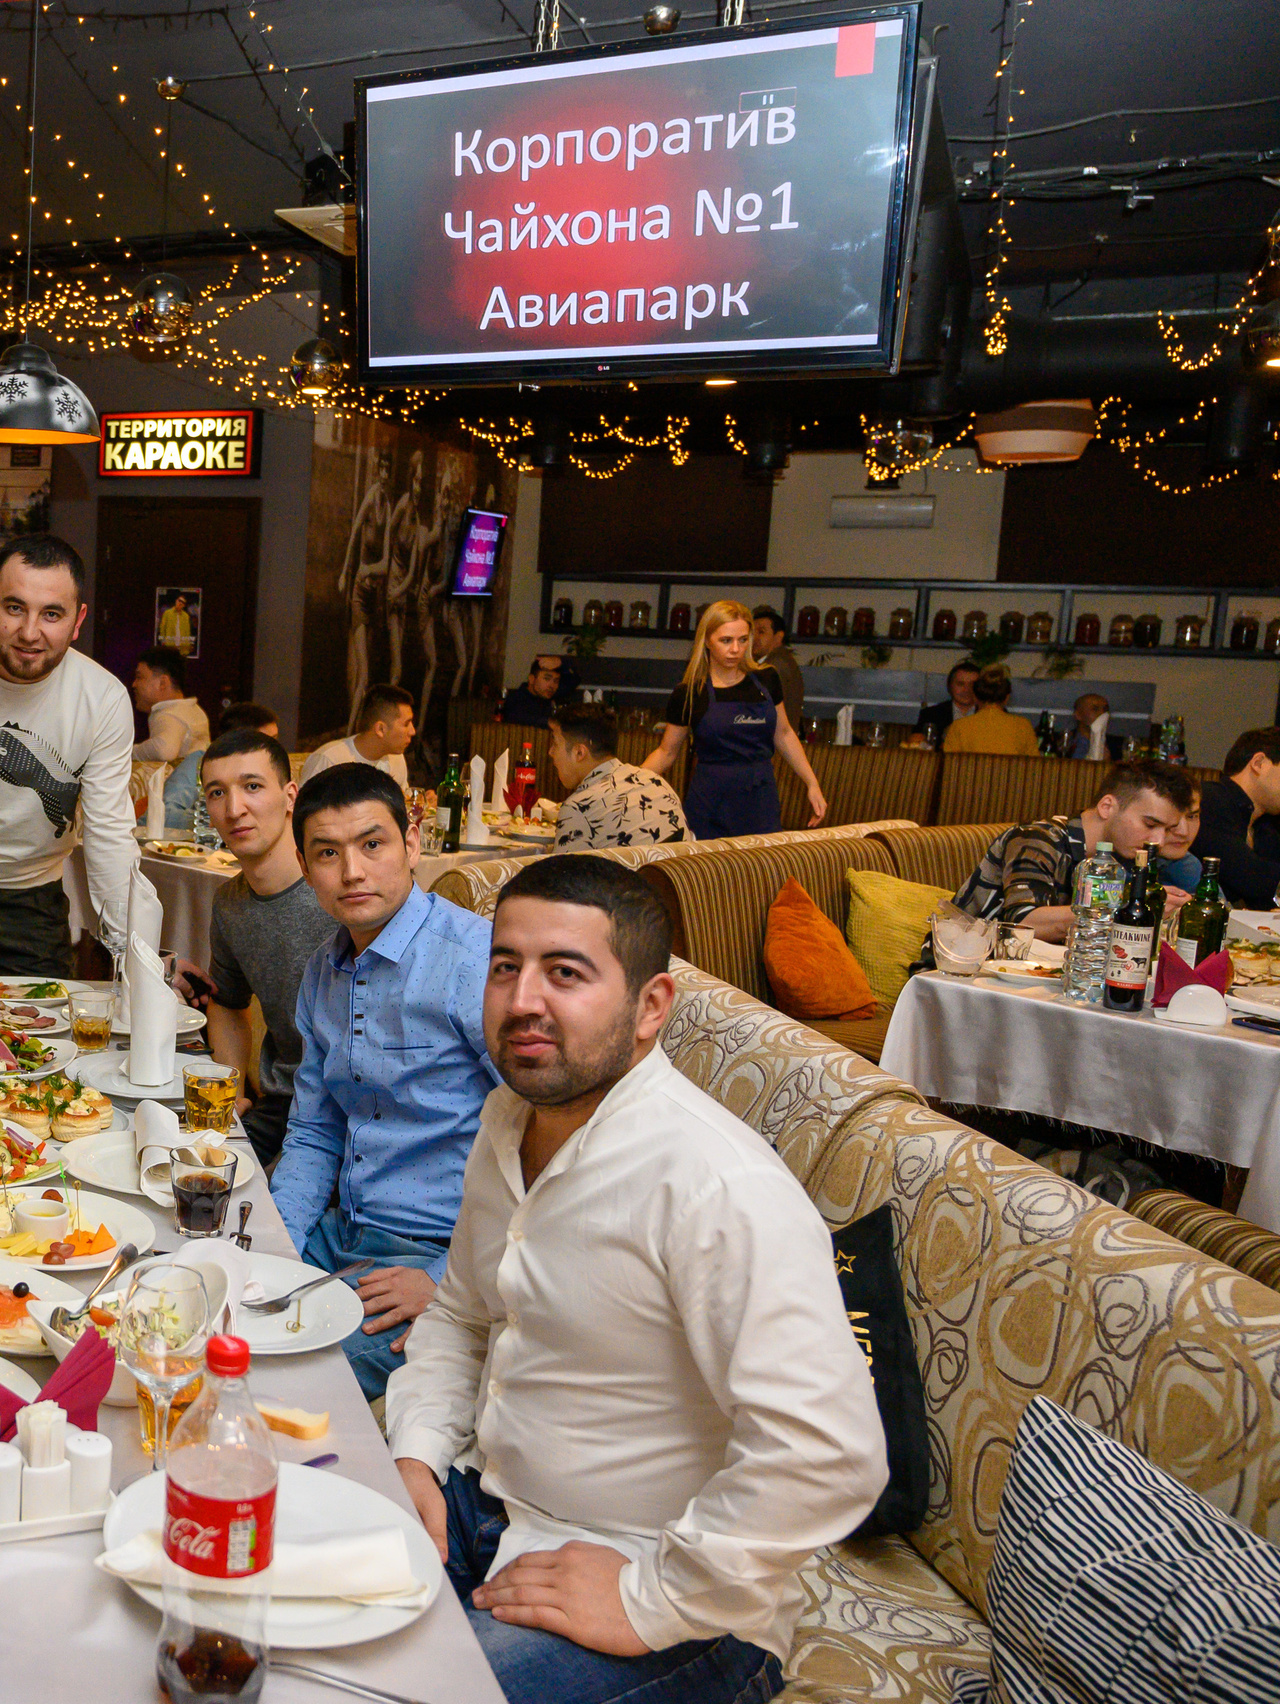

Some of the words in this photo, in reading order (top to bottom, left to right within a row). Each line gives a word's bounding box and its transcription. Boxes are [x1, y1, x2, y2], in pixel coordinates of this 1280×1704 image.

[453, 105, 797, 182] Корпоратив
[444, 202, 670, 255] Чайхона
[695, 182, 800, 238] №1
[479, 280, 751, 331] Авиапарк
[106, 418, 247, 438] ТЕРРИТОРИЯ
[105, 440, 245, 470] КАРАОКЕ
[1113, 929, 1151, 943] STEAKWINE
